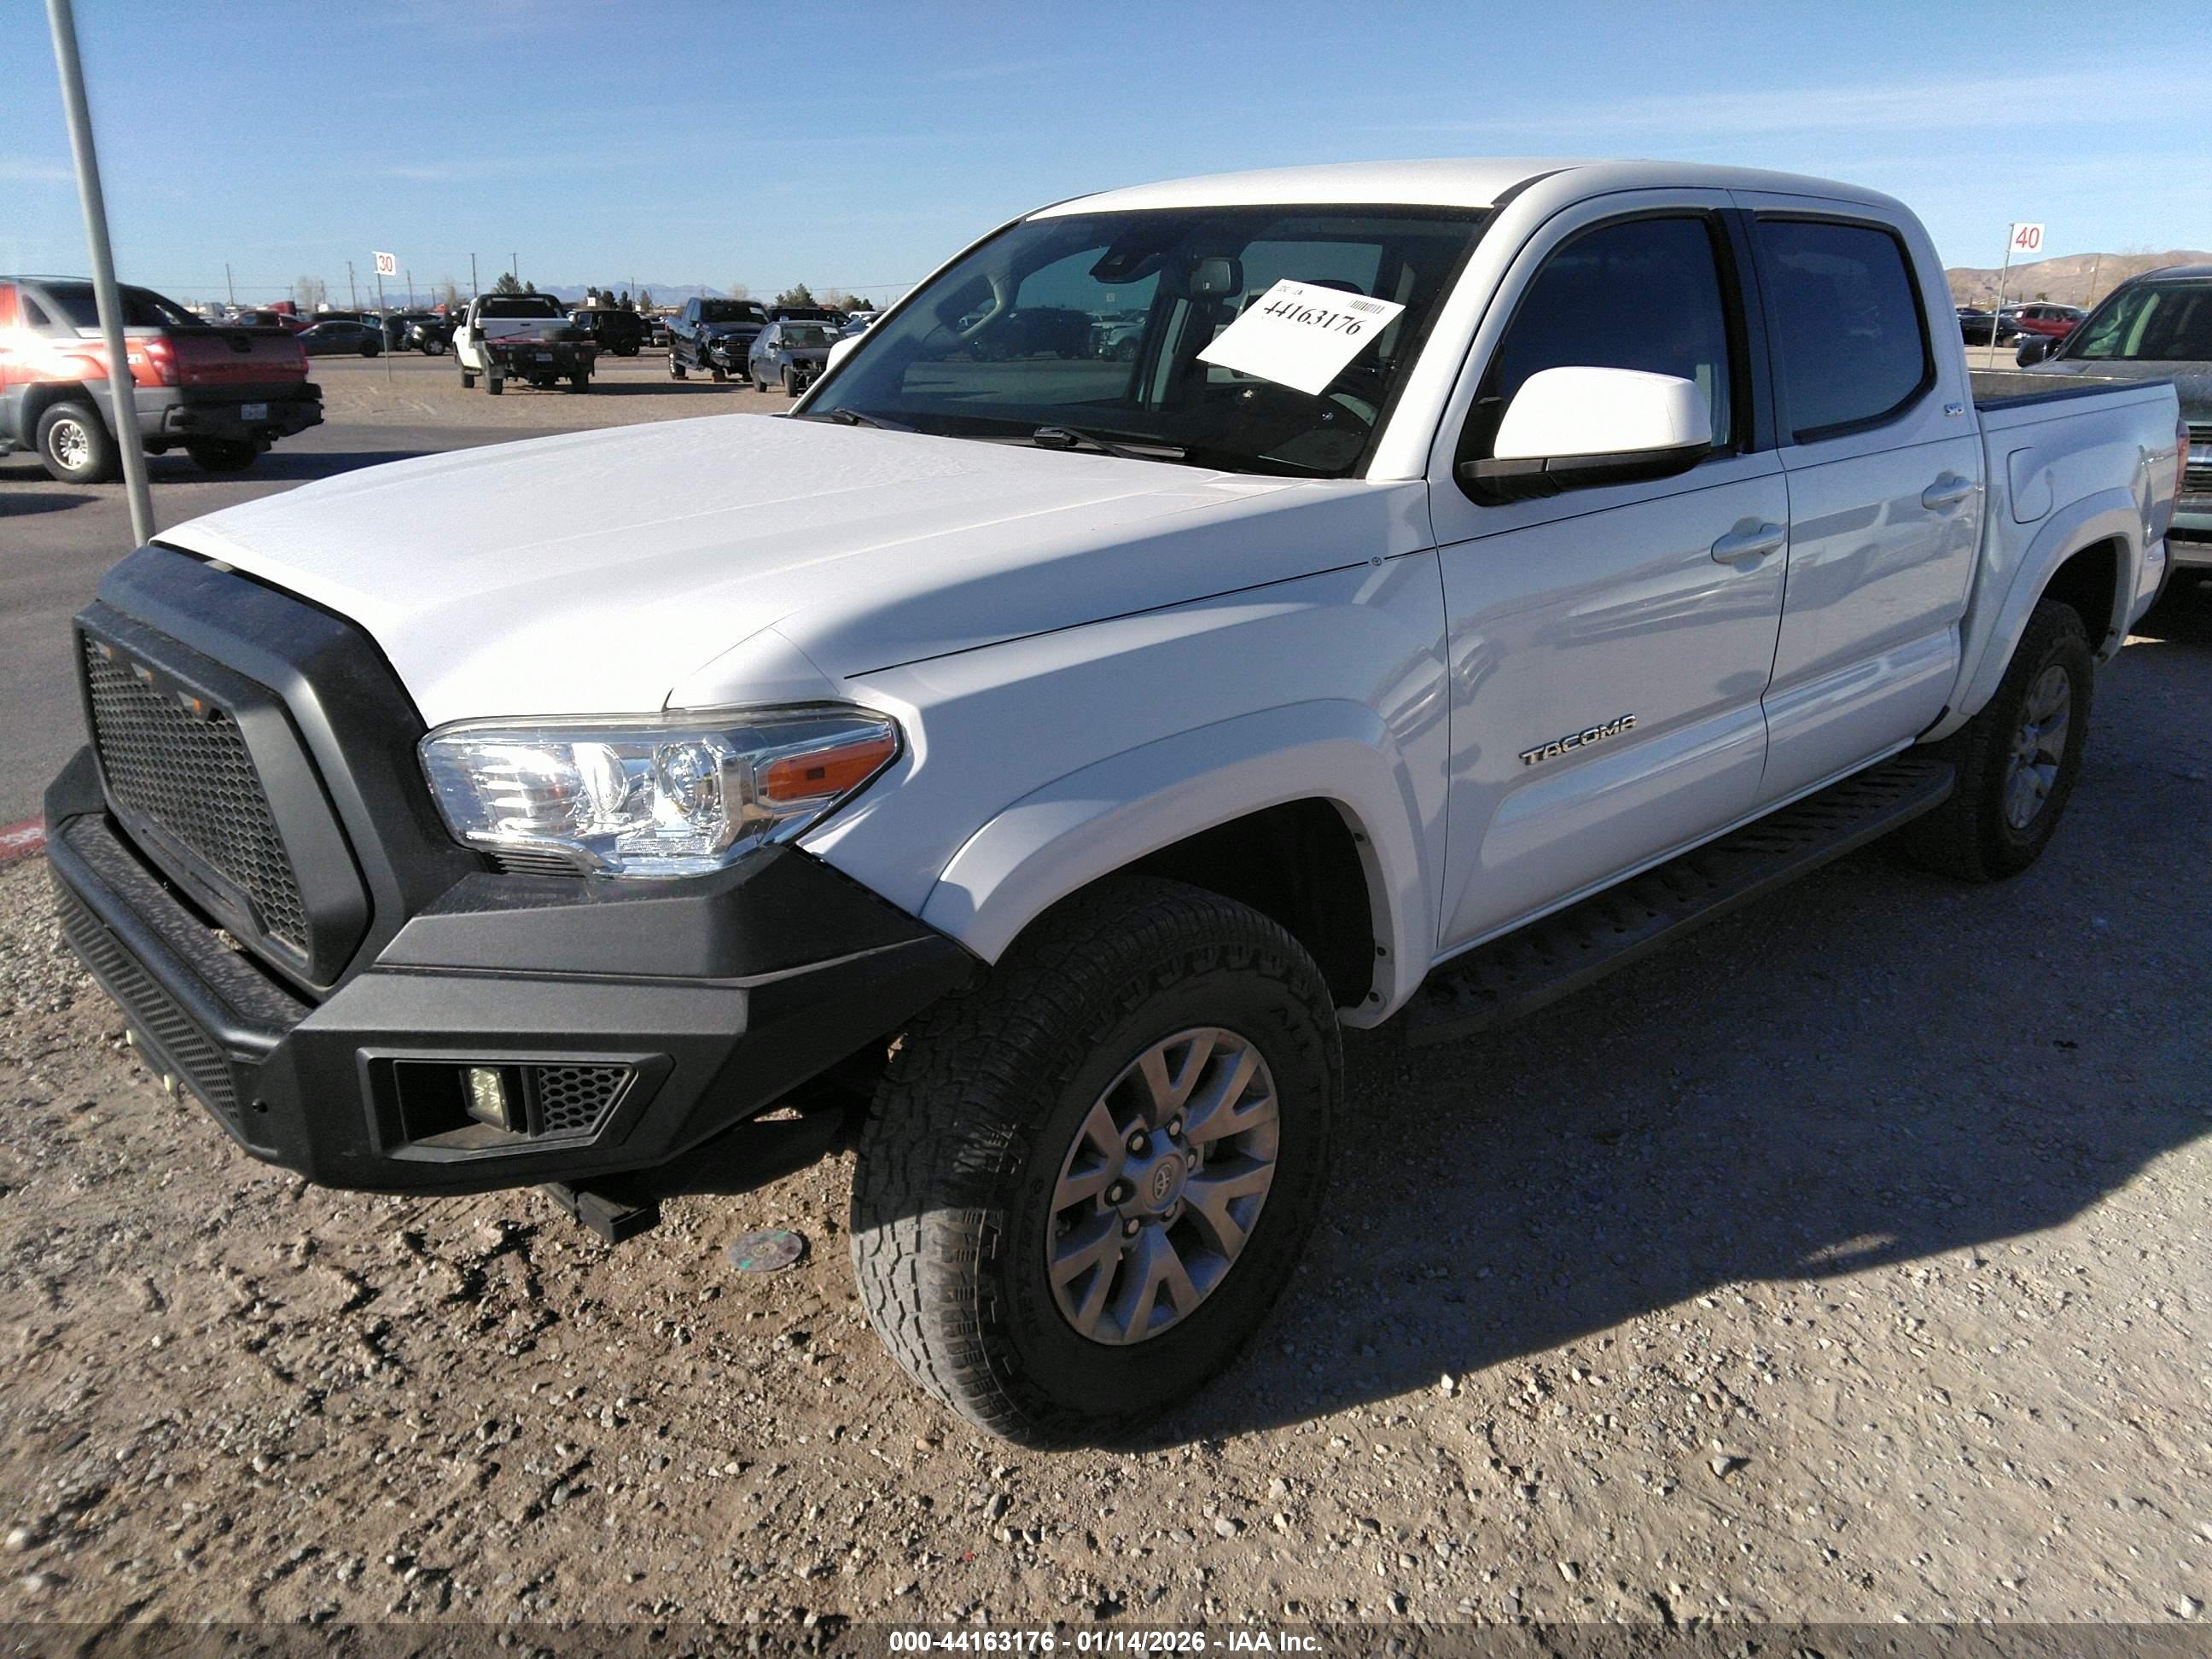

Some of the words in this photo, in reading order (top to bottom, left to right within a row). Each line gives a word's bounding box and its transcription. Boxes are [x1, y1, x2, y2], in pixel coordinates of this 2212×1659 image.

[2015, 226, 2040, 249] 40
[378, 255, 393, 272] 30
[1264, 300, 1367, 335] 44163176
[1518, 713, 1638, 765] TACOMA
